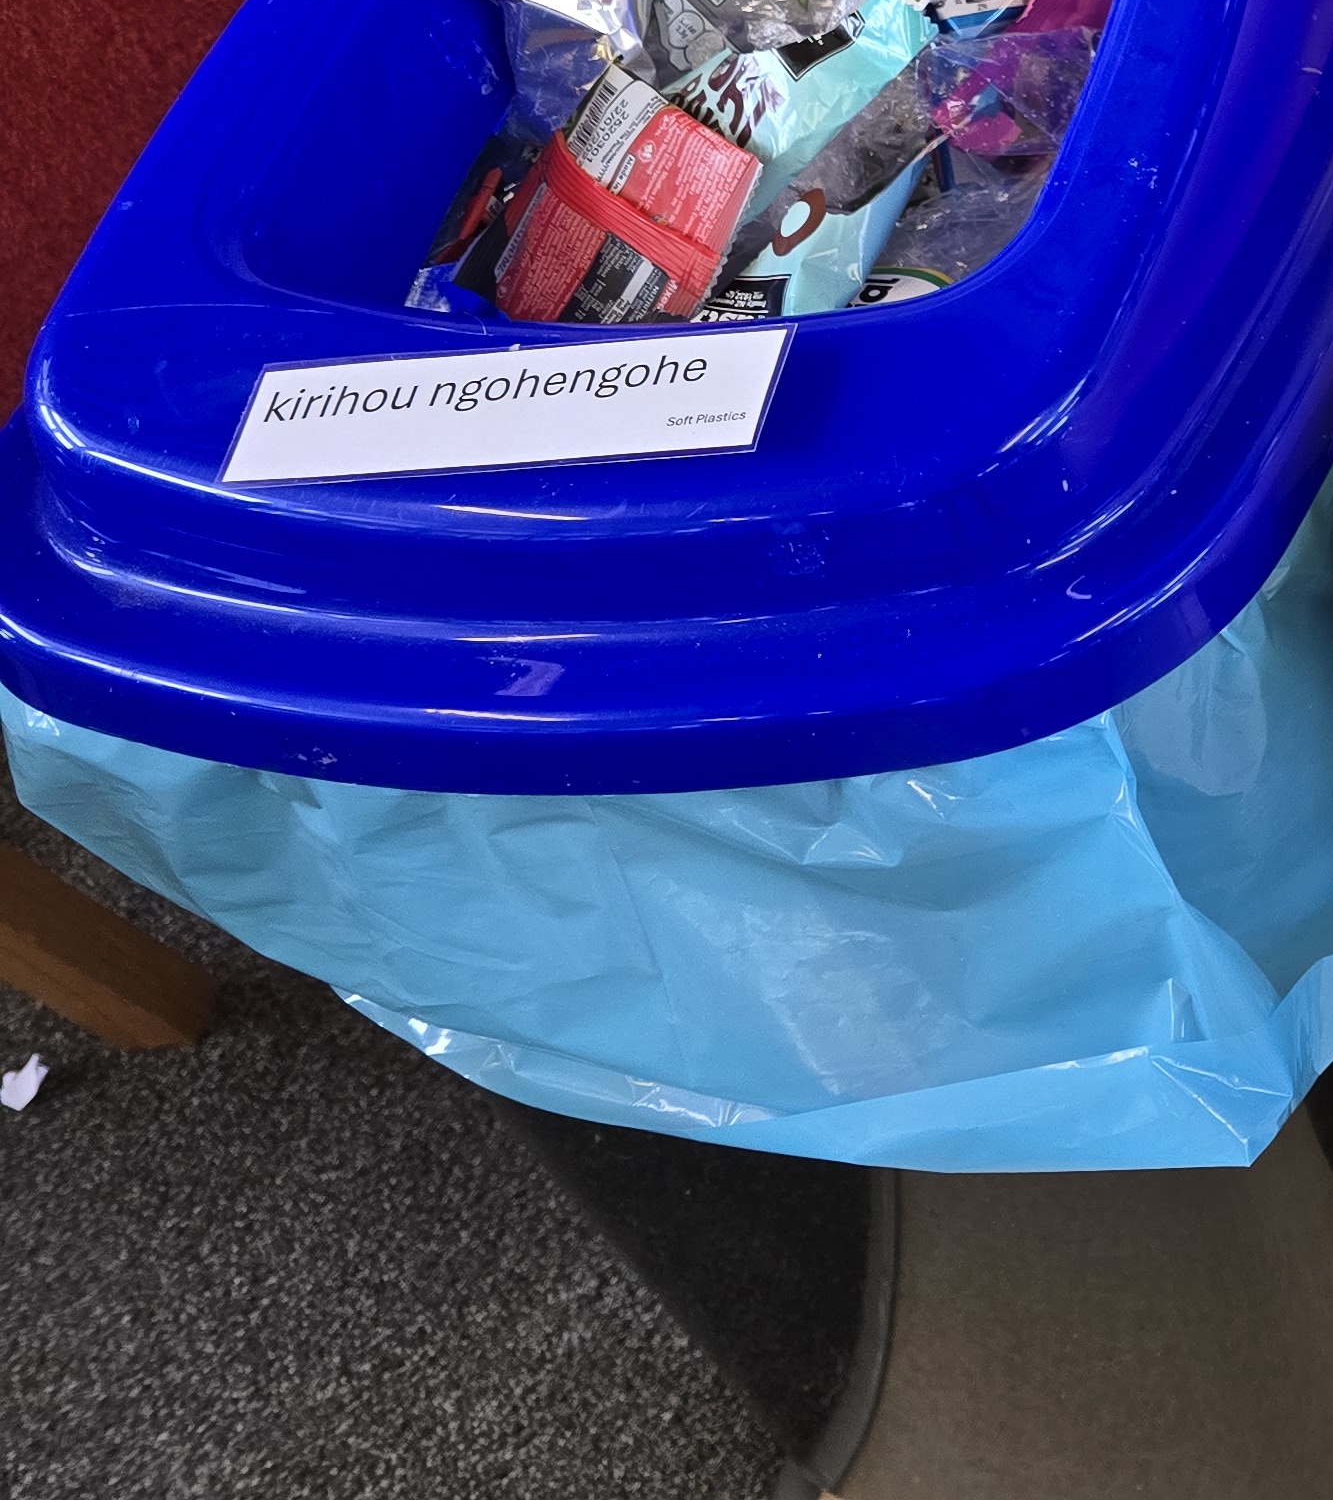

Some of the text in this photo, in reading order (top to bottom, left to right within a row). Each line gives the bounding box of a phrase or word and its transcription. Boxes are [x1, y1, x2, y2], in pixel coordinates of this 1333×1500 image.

[264, 355, 707, 422] kirihou ngohengohe
[667, 412, 746, 426] Soft Plastics
